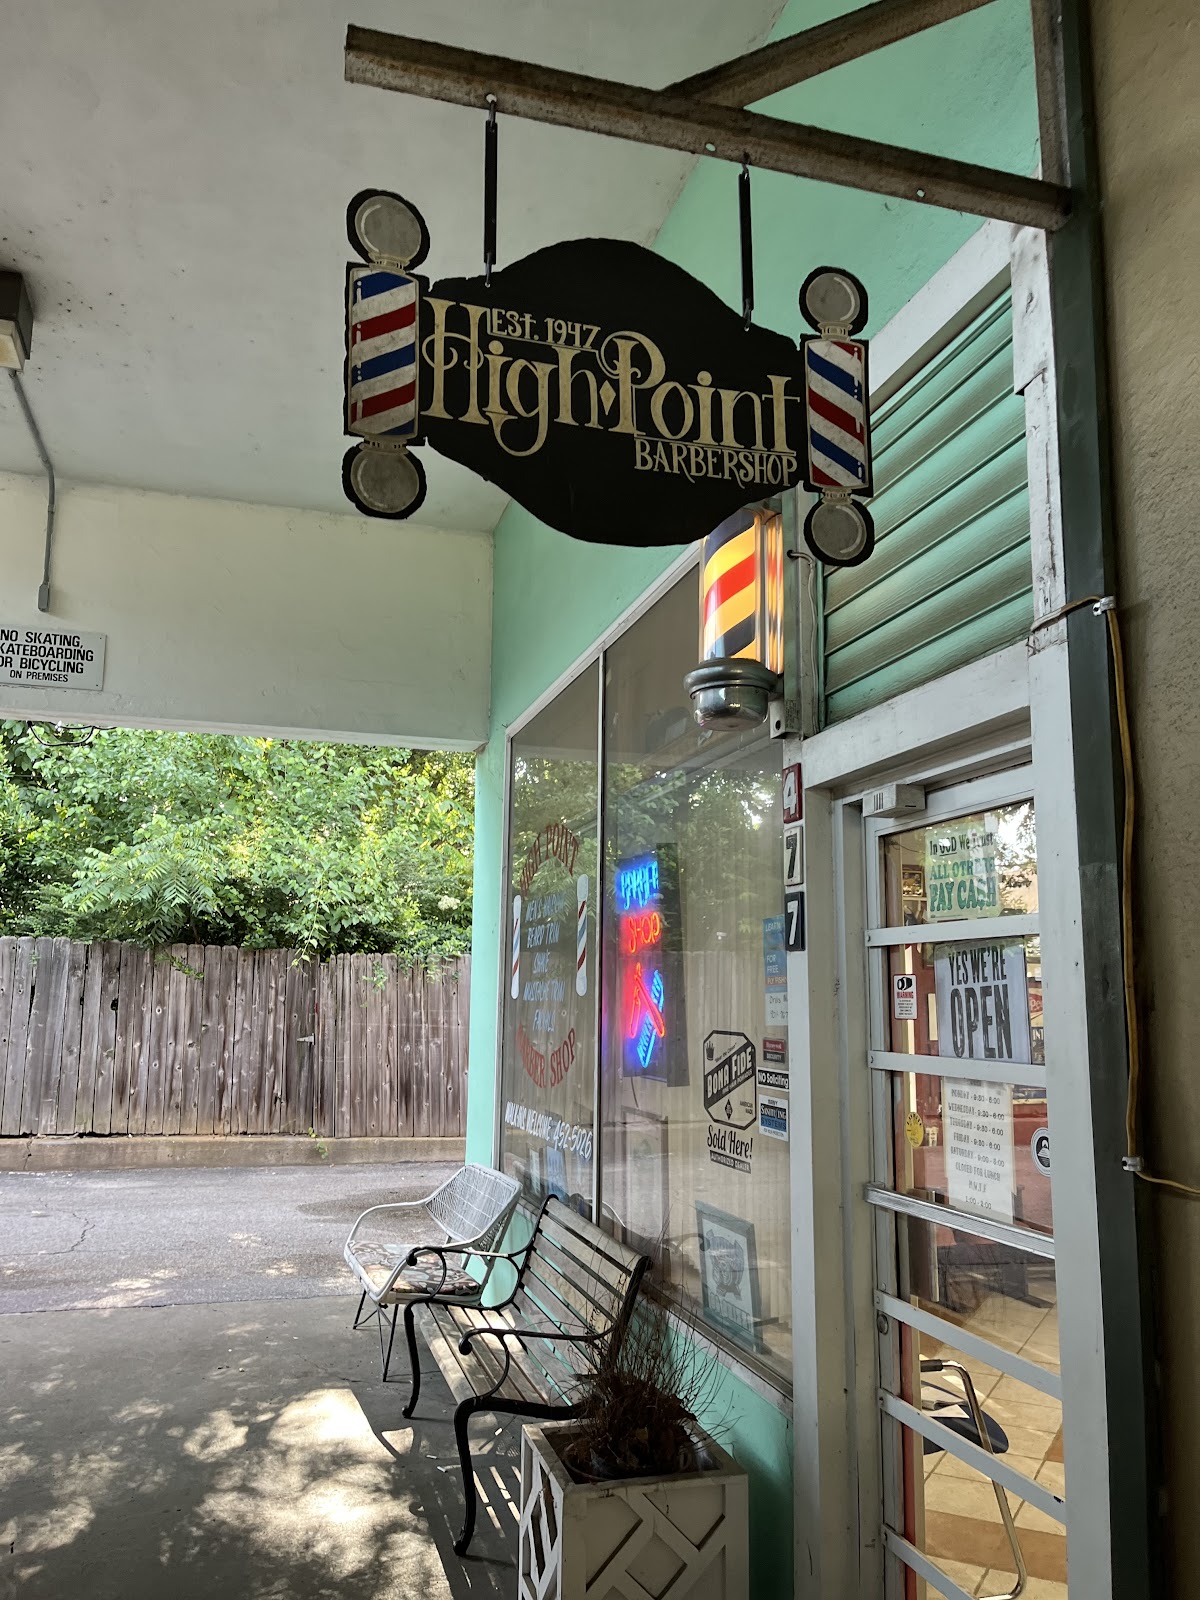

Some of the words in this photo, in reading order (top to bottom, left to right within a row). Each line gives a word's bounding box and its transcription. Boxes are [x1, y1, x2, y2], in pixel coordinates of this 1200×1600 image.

[544, 317, 602, 349] 1947
[420, 296, 604, 457] High
[600, 331, 800, 453] Point
[634, 438, 798, 489] BARBERSHOP
[0, 629, 18, 642] NO
[25, 631, 83, 649] SKATING,
[10, 669, 22, 679] ON
[26, 671, 69, 682] PREMISES
[20, 657, 84, 674] BICYCLING
[545, 823, 579, 877] POINT
[930, 840, 938, 856] In
[930, 865, 950, 880] ALL
[929, 881, 954, 912] PAY
[629, 912, 661, 953] SHOP
[767, 965, 779, 974] FREE
[948, 950, 969, 986] YES
[970, 944, 1007, 983] WE'RE
[950, 983, 1012, 1059] OPEN
[550, 1028, 576, 1088] SHOP
[731, 1045, 753, 1080] FIDE
[707, 1124, 727, 1152] Sold
[728, 1130, 753, 1160] Here!
